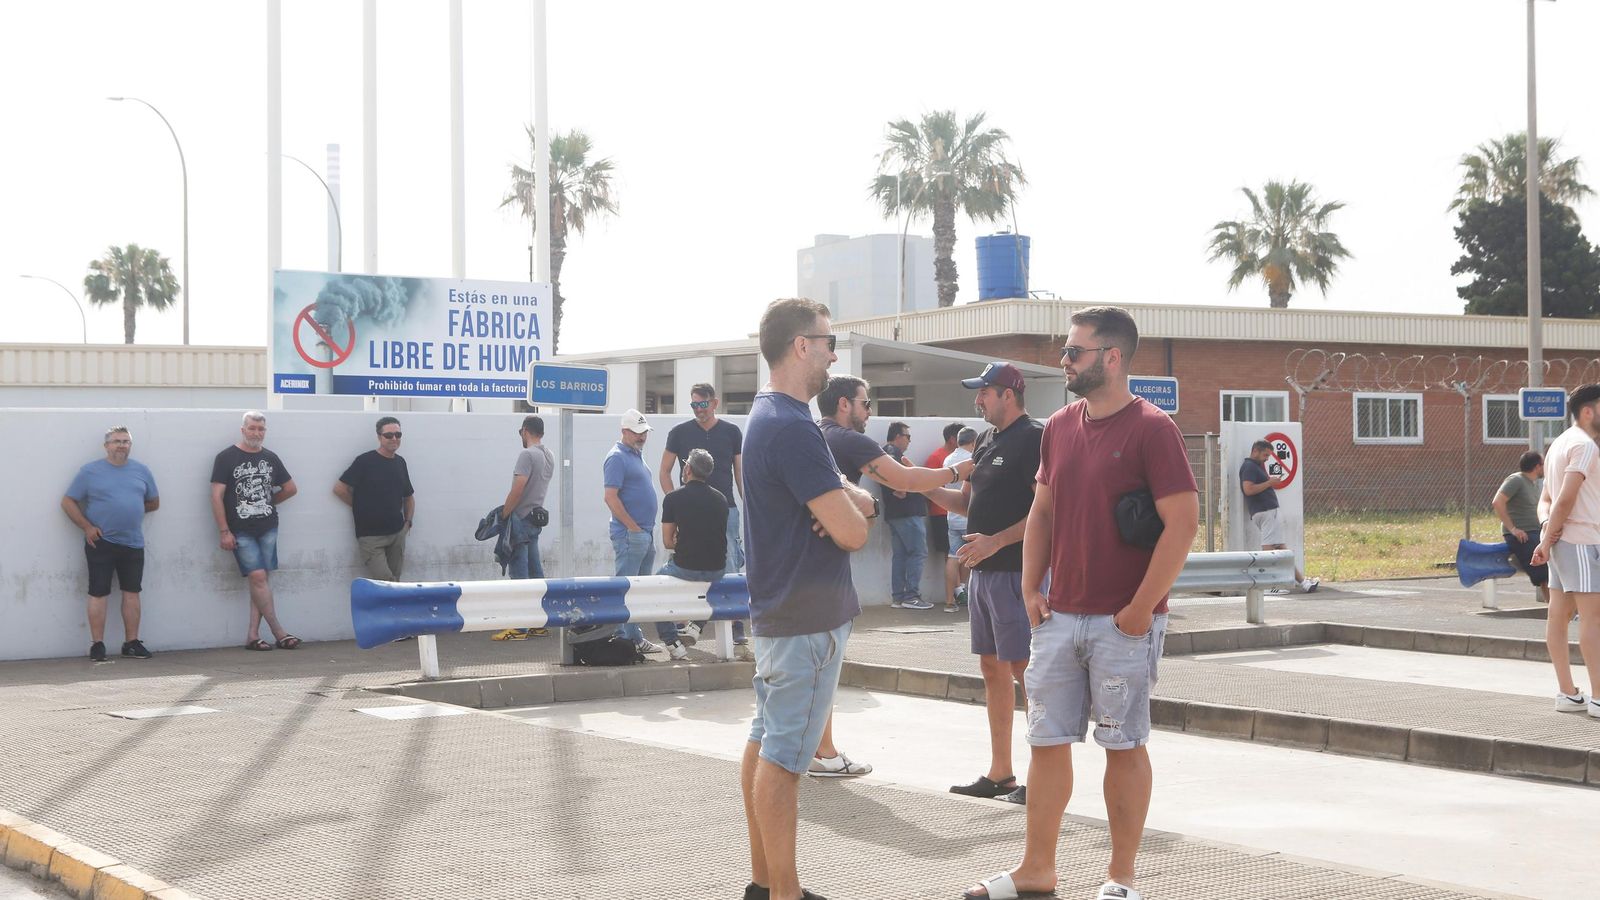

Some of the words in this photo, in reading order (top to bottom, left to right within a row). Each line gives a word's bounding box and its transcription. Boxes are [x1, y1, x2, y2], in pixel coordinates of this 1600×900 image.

[449, 289, 487, 304] Estás
[491, 294, 508, 305] en
[513, 295, 538, 307] una
[448, 304, 541, 340] FÁBRICA
[369, 340, 434, 370] LIBRE
[443, 342, 470, 371] DE
[479, 344, 541, 373] HUMO
[368, 380, 414, 391] Prohibido
[416, 382, 443, 392] fumar
[445, 384, 456, 392] en
[458, 383, 479, 392] toda
[481, 383, 490, 393] la
[535, 379, 556, 389] LOS
[560, 380, 604, 392] BARRIOS
[1134, 385, 1172, 394] ALGECIRAS
[1144, 397, 1176, 406] ALADILLO
[1527, 395, 1561, 403] ALGECIRAS
